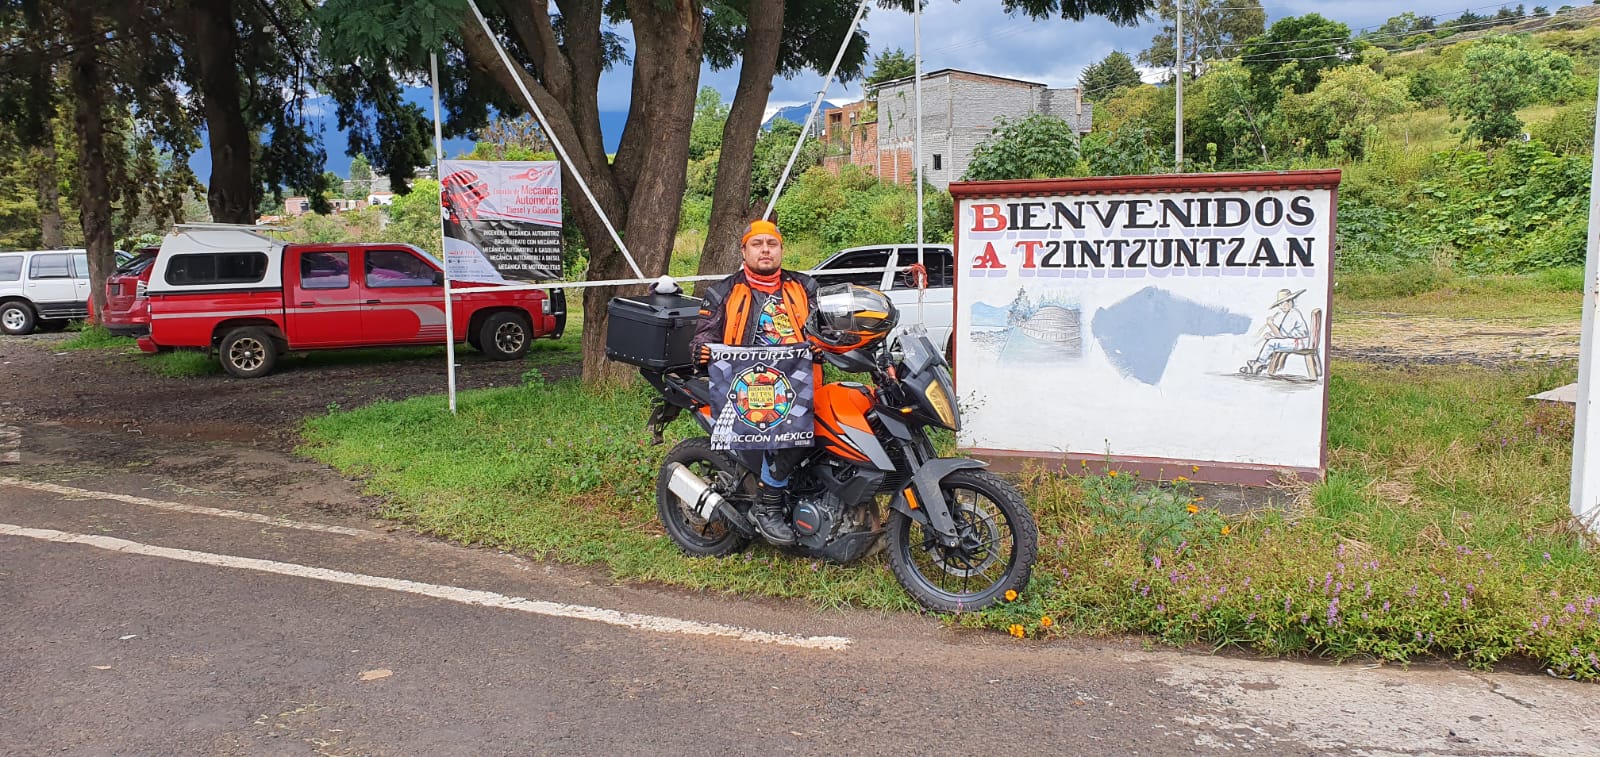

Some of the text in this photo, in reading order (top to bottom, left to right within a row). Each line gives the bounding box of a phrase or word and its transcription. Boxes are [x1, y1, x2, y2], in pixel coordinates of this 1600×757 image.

[522, 185, 558, 195] Mecánica
[516, 195, 558, 205] Automotriz
[507, 206, 525, 214] Diesel
[532, 206, 559, 214] Gasolina
[970, 195, 1316, 232] BIENVENIDOS
[973, 237, 1316, 269] A TZINTZUNTZAN
[711, 348, 810, 361] MOTOTURISTA
[730, 433, 771, 443] ACCIÓN
[774, 431, 814, 442] MÉXICO
